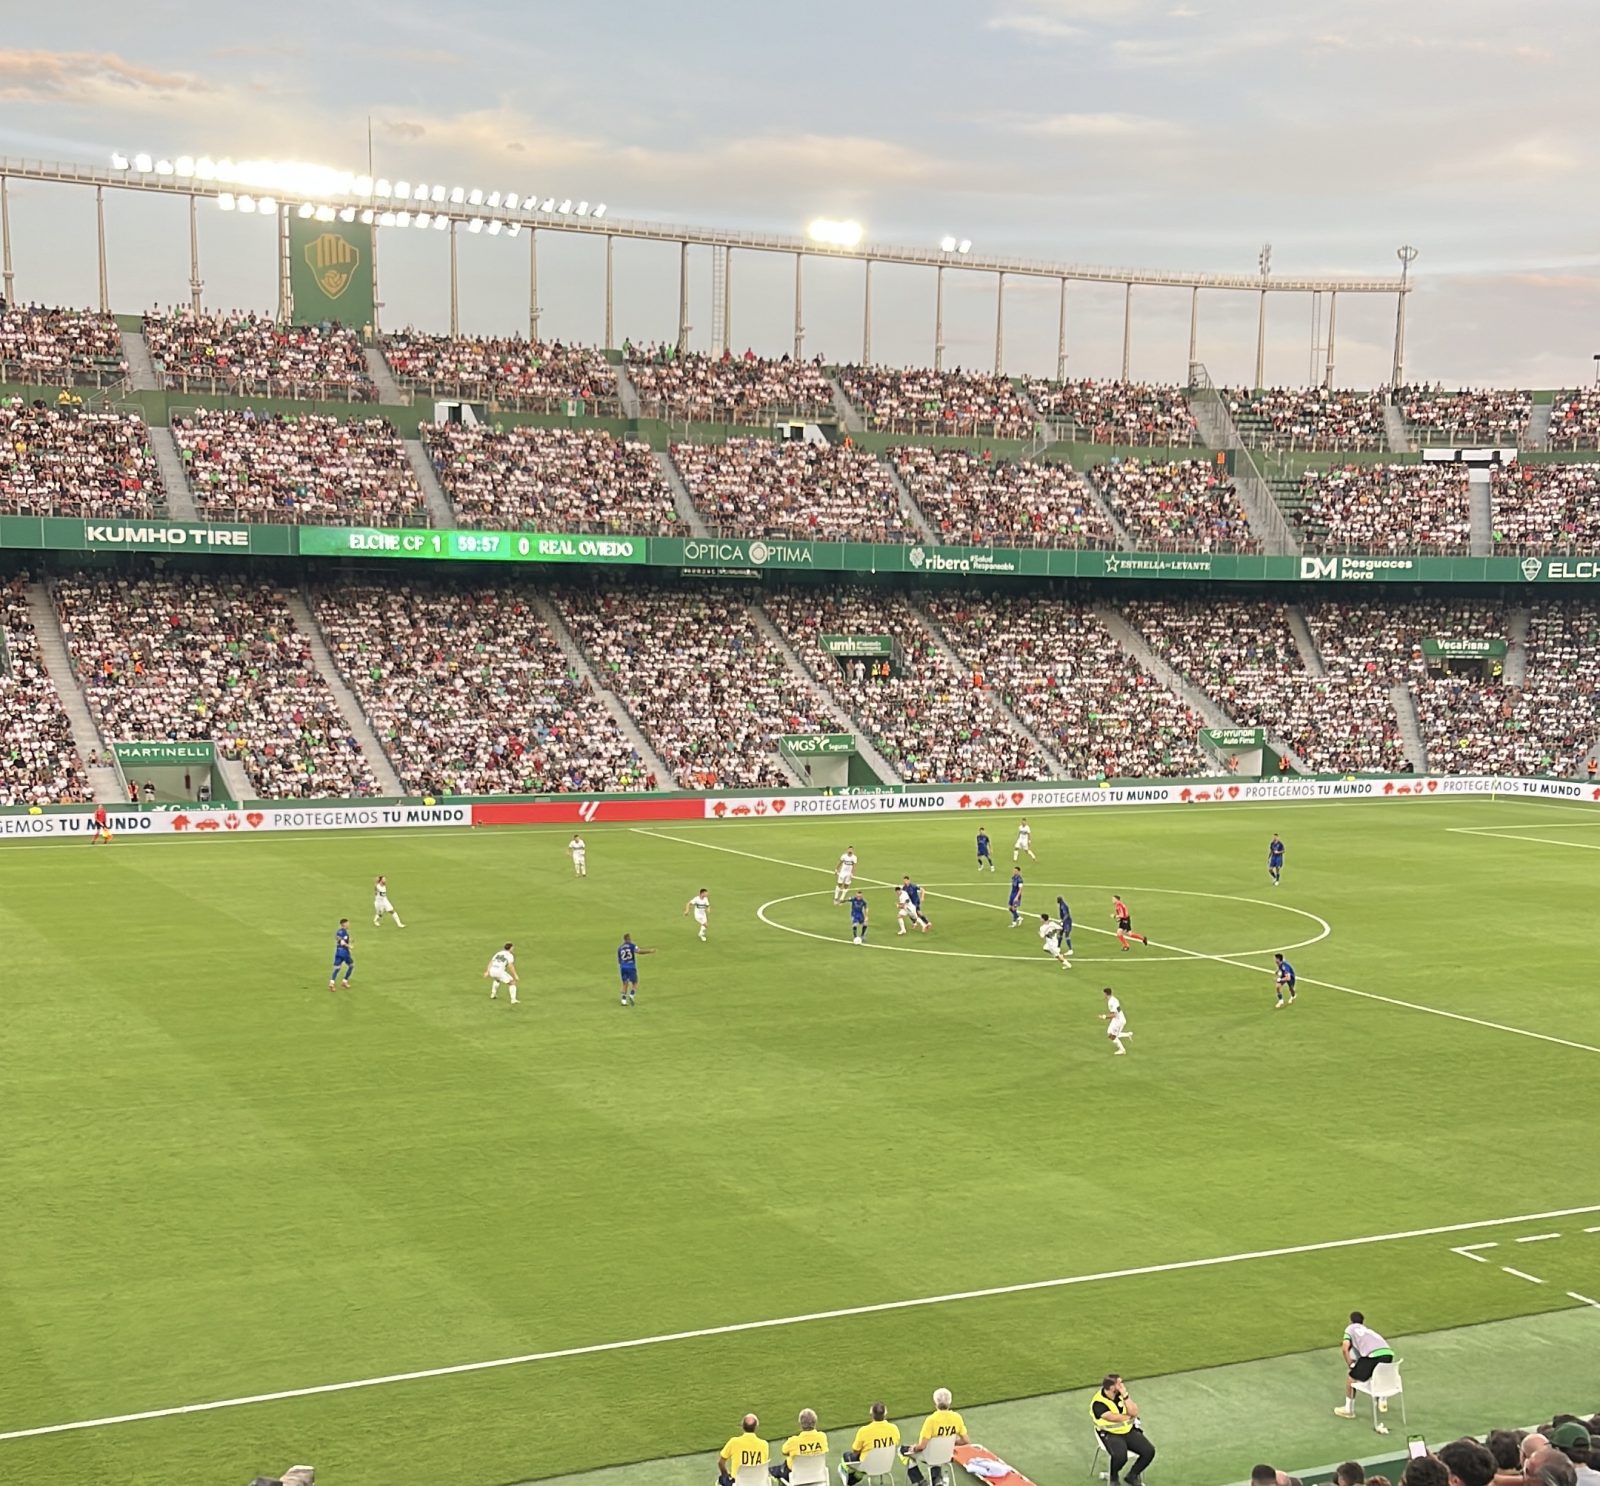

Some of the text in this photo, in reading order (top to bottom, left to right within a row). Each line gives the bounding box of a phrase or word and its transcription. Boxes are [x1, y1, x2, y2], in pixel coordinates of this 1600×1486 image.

[88, 526, 249, 546] KUMHO TIRE
[350, 534, 440, 552] ELCHE CF 1
[519, 539, 633, 557] 0 REAL OVIEDO
[925, 555, 969, 570] ribera
[1120, 560, 1165, 569] ESTRELLA
[1171, 561, 1211, 570] LEVANTE
[1300, 557, 1338, 579] DM
[1342, 558, 1413, 570] Desguaces
[1342, 569, 1374, 579] Mora
[830, 637, 855, 651] umh
[119, 748, 209, 757] MARTINELLI
[788, 740, 816, 751] MGS
[1246, 783, 1372, 797] PROTEGEMOS TU MUNDO
[1443, 780, 1581, 797] PROTEGEMOS TU MUNDO
[1031, 789, 1169, 804] PROTEGEMOS TU MUNDO
[793, 796, 945, 812] PROTEGEMOS TU MUNDO
[59, 819, 80, 831] TU
[274, 809, 464, 827] PROTEGEMOS TU MUNDO
[620, 948, 633, 961] 23
[938, 1426, 957, 1436] DYA
[799, 1442, 822, 1452] DYA
[742, 1450, 762, 1465] DYA
